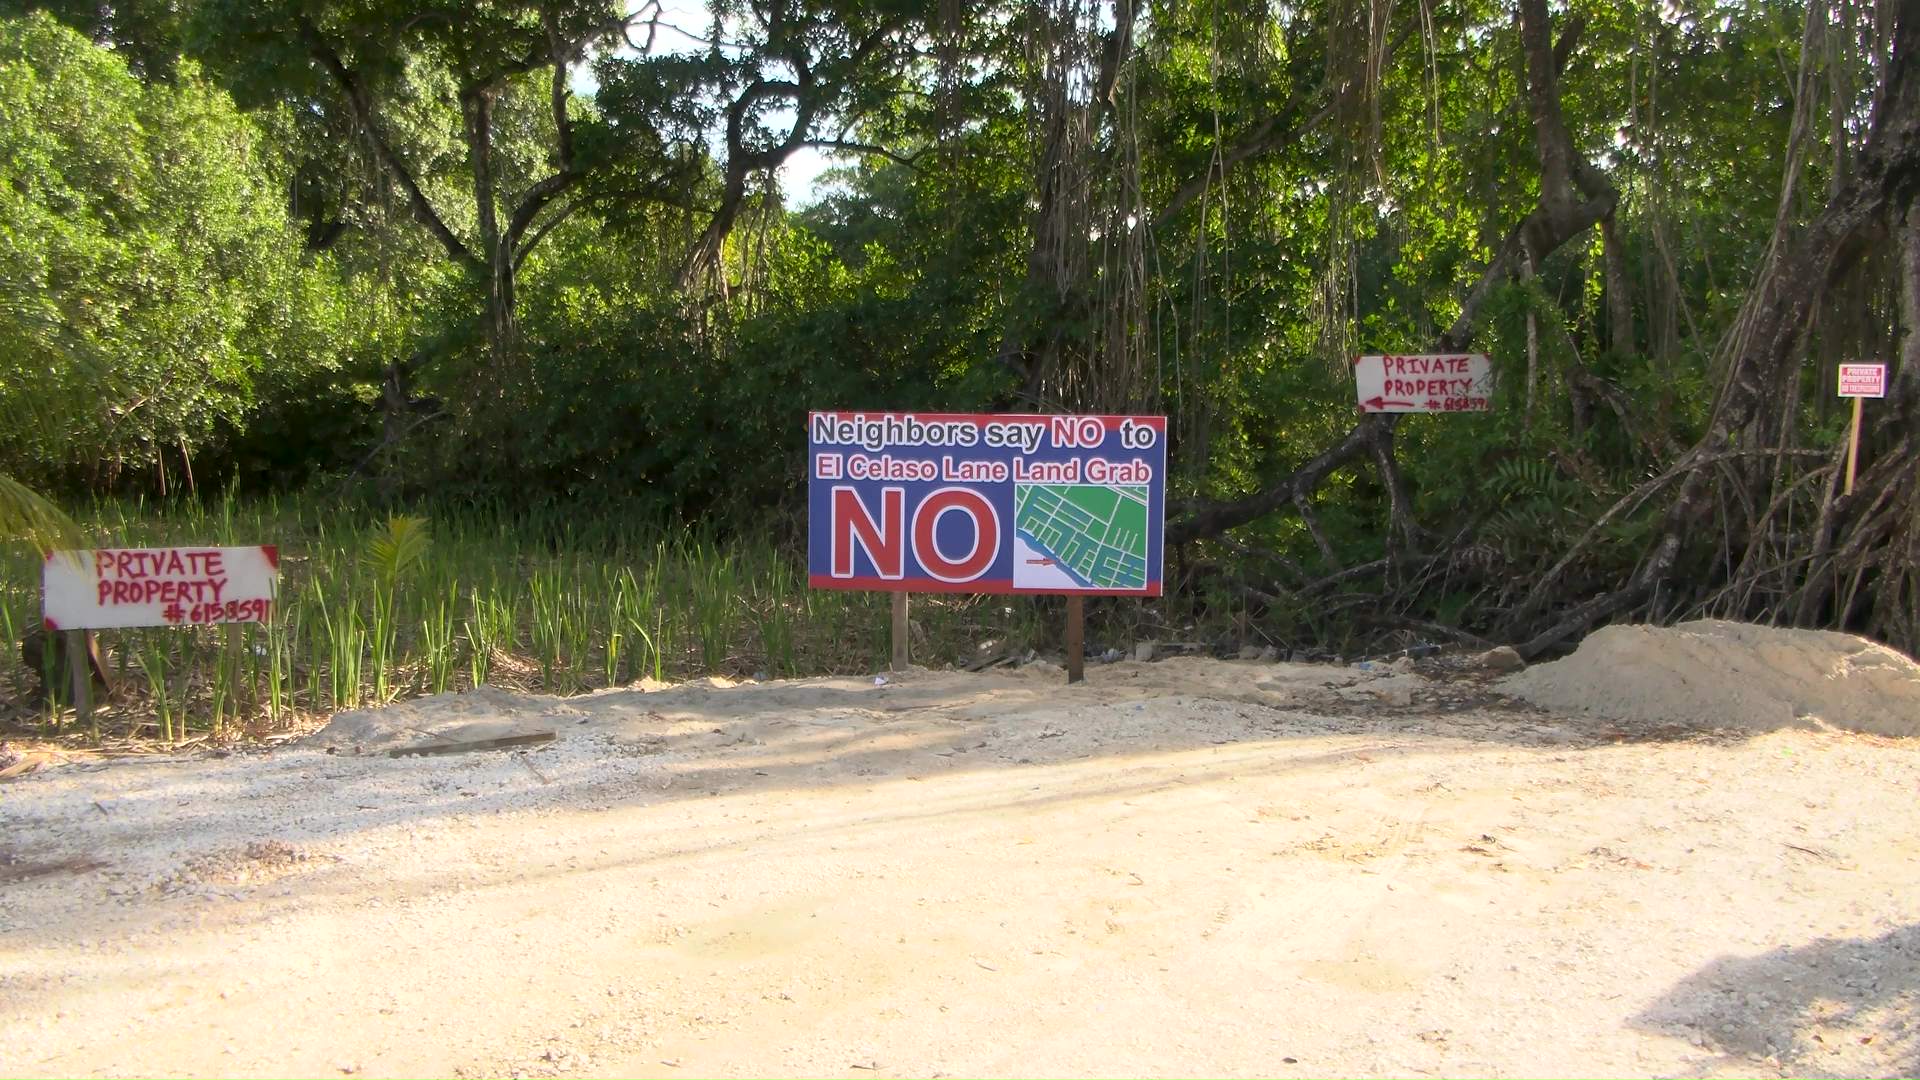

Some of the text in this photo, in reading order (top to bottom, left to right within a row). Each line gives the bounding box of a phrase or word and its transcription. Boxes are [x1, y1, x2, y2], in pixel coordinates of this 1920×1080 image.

[1383, 355, 1469, 376] PRIVATE
[1384, 378, 1473, 396] PROPERTY
[814, 415, 1155, 452] Neighbors say NO to
[817, 454, 1151, 483] El Celaso Lane Land Grab
[832, 486, 1000, 583] NO
[97, 551, 225, 579] PRIVATE
[99, 578, 227, 605] PROPERTY
